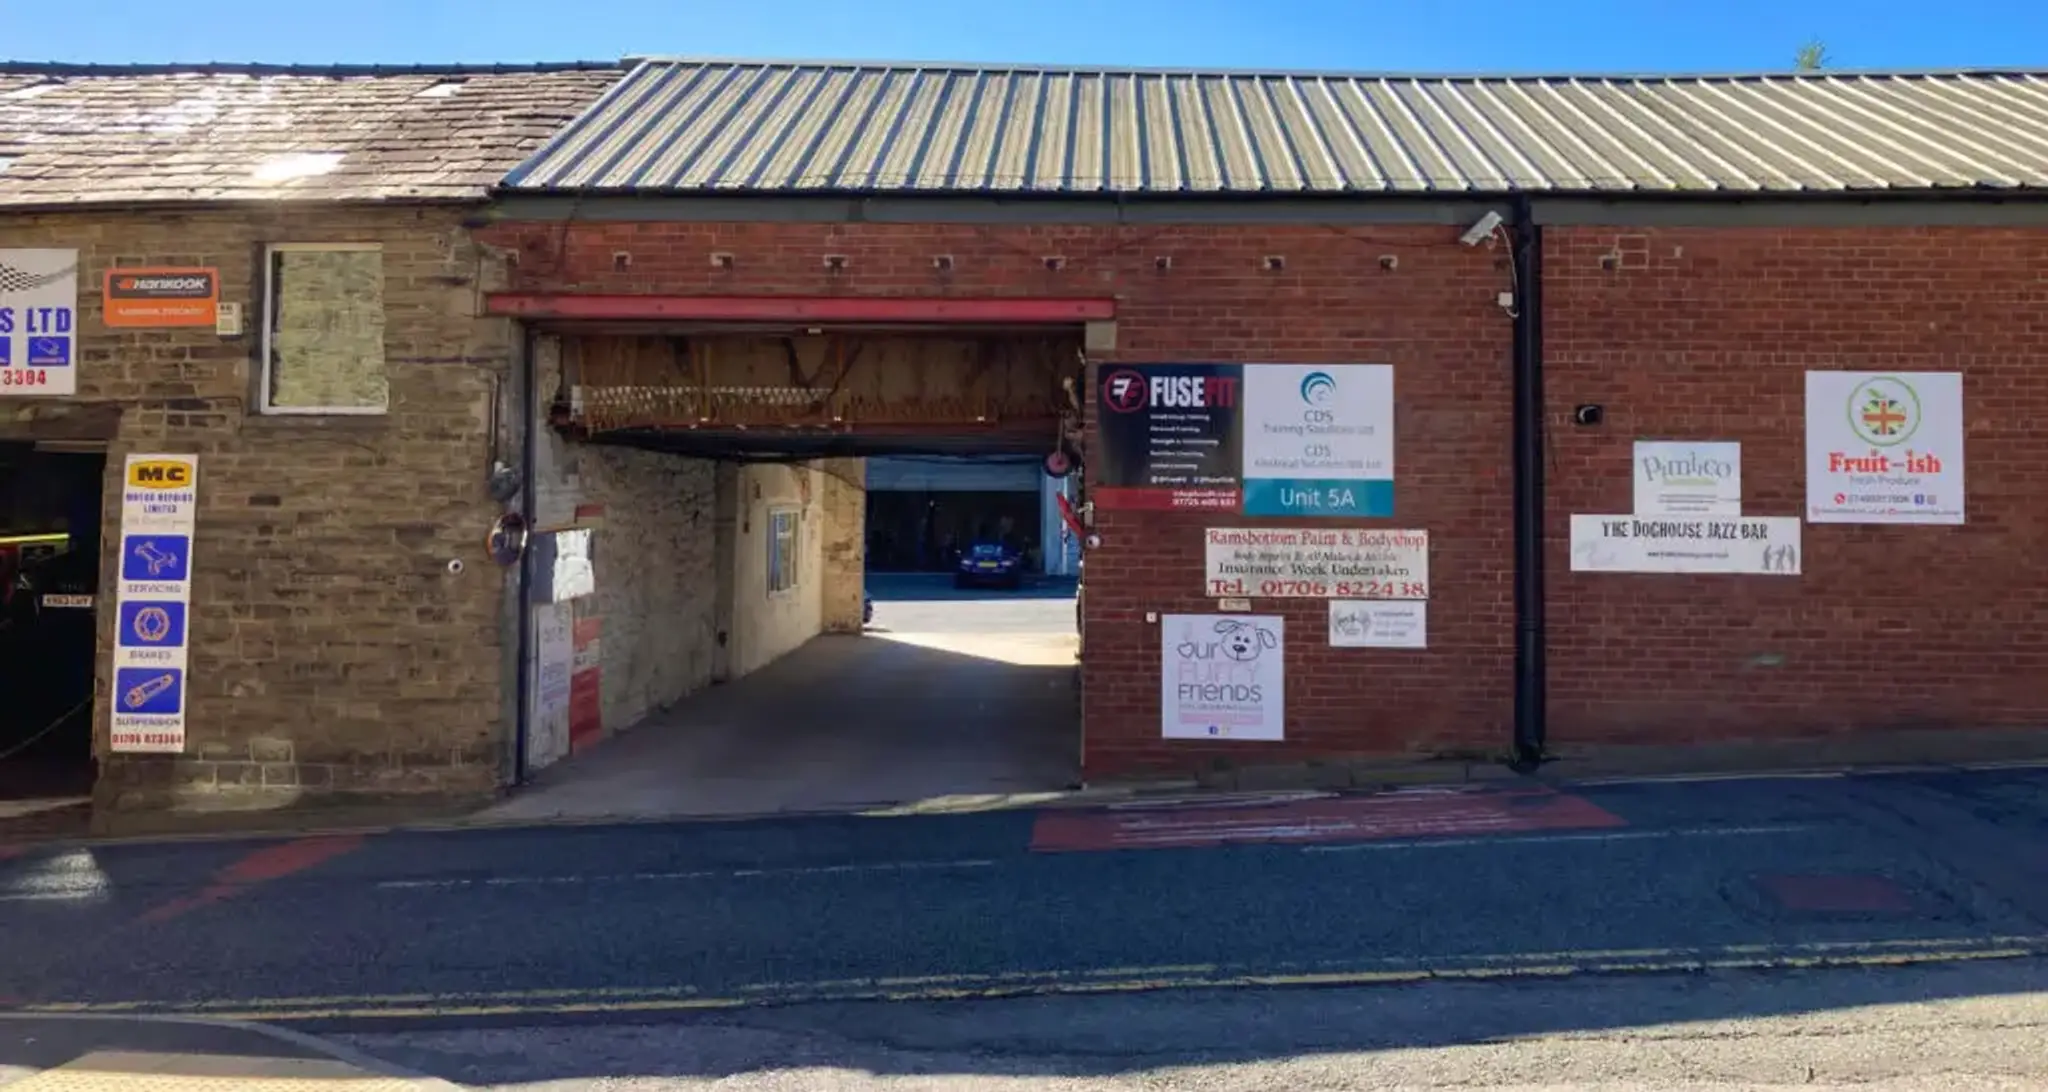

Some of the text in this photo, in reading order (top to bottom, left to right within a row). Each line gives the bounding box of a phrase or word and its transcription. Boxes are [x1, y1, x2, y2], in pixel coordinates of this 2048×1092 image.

[26, 307, 72, 334] LTD
[1149, 375, 1236, 408] FUSEFIT
[1303, 409, 1334, 422] CDS
[1827, 448, 1942, 474] Fruit-ish
[137, 466, 185, 481] MC
[1280, 487, 1356, 508] Unit 5A
[1602, 520, 1768, 539] THE DOGHOUSE JAZZ BAR
[1208, 530, 1426, 550] Ramsbottom Paint & Bodyshop
[1218, 562, 1410, 578] Insurance Work Undertaken
[127, 584, 182, 593] SERVICING
[1210, 578, 1251, 596] Tel.
[1260, 580, 1328, 596] 01706
[129, 650, 172, 661] BRAKES
[115, 717, 181, 726] SUSPENSION
